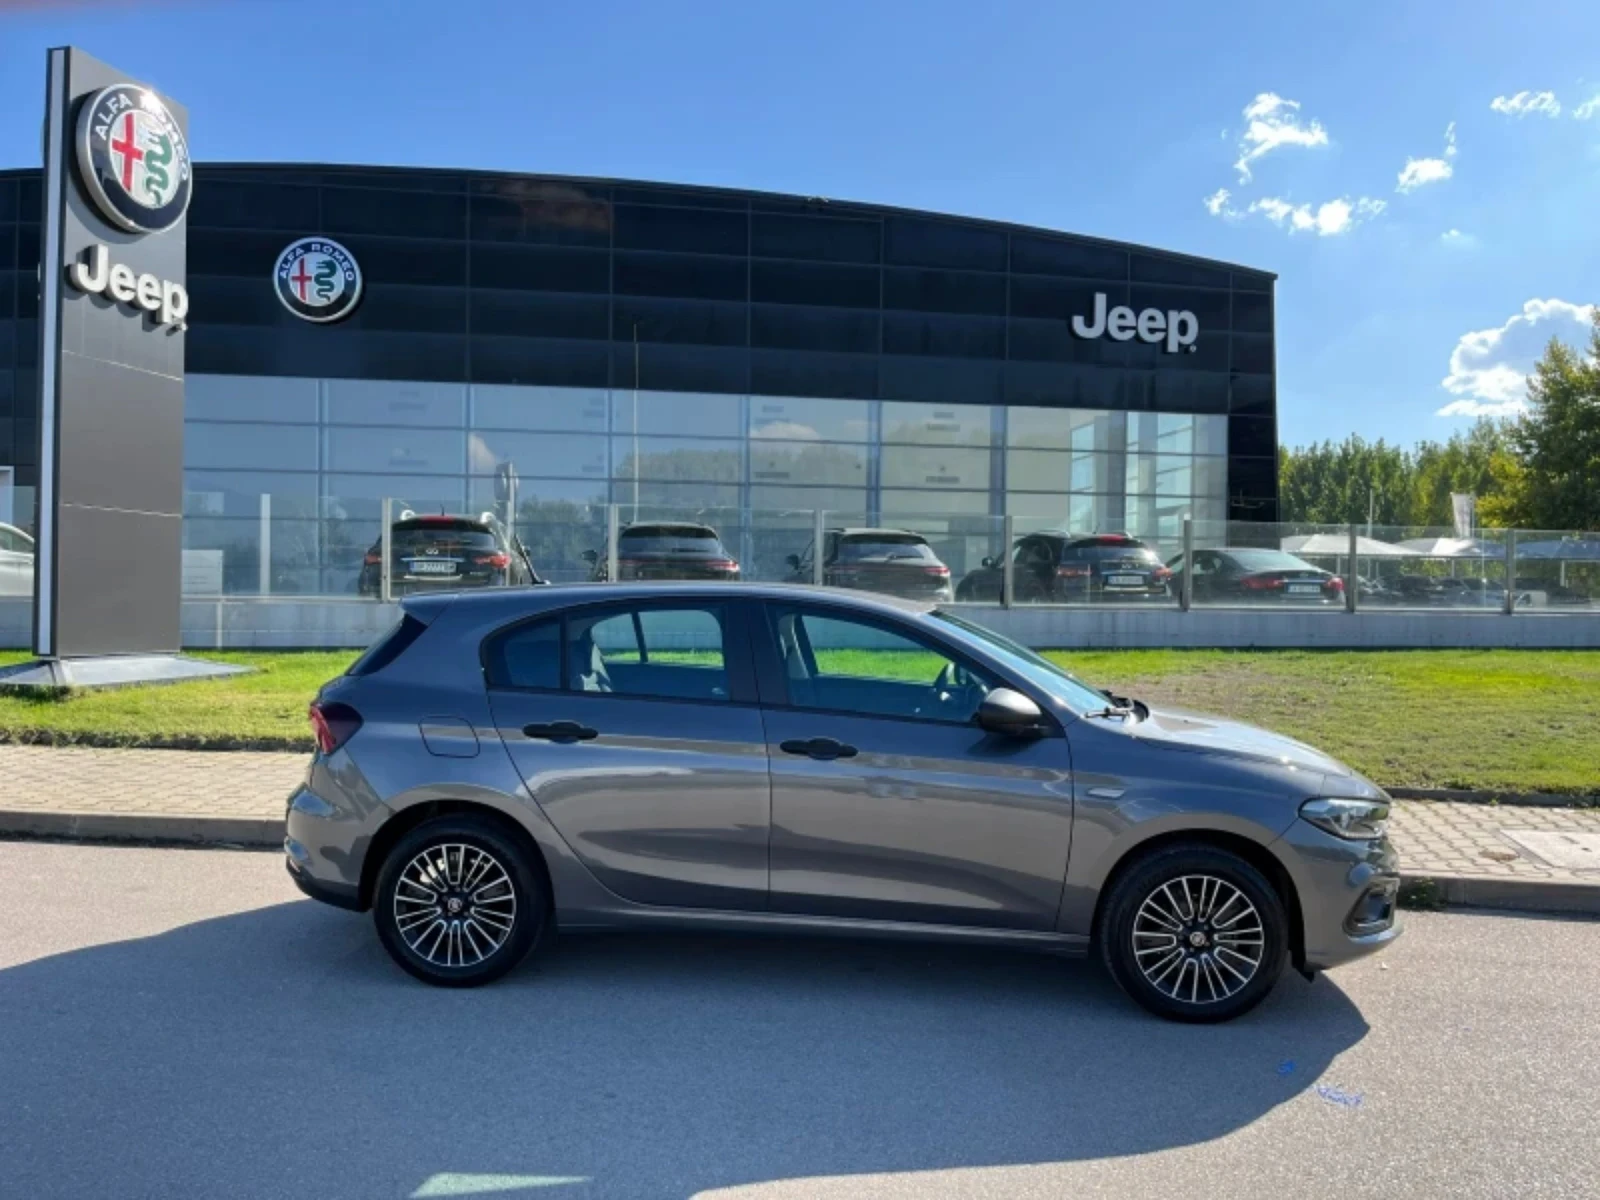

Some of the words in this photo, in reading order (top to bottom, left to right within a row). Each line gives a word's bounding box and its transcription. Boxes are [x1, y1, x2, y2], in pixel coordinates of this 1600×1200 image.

[95, 93, 133, 141] ALFA
[75, 244, 188, 323] Jeep
[279, 246, 305, 279] ALFA
[311, 243, 354, 281] ROMEO
[1072, 291, 1199, 353] Jeep
